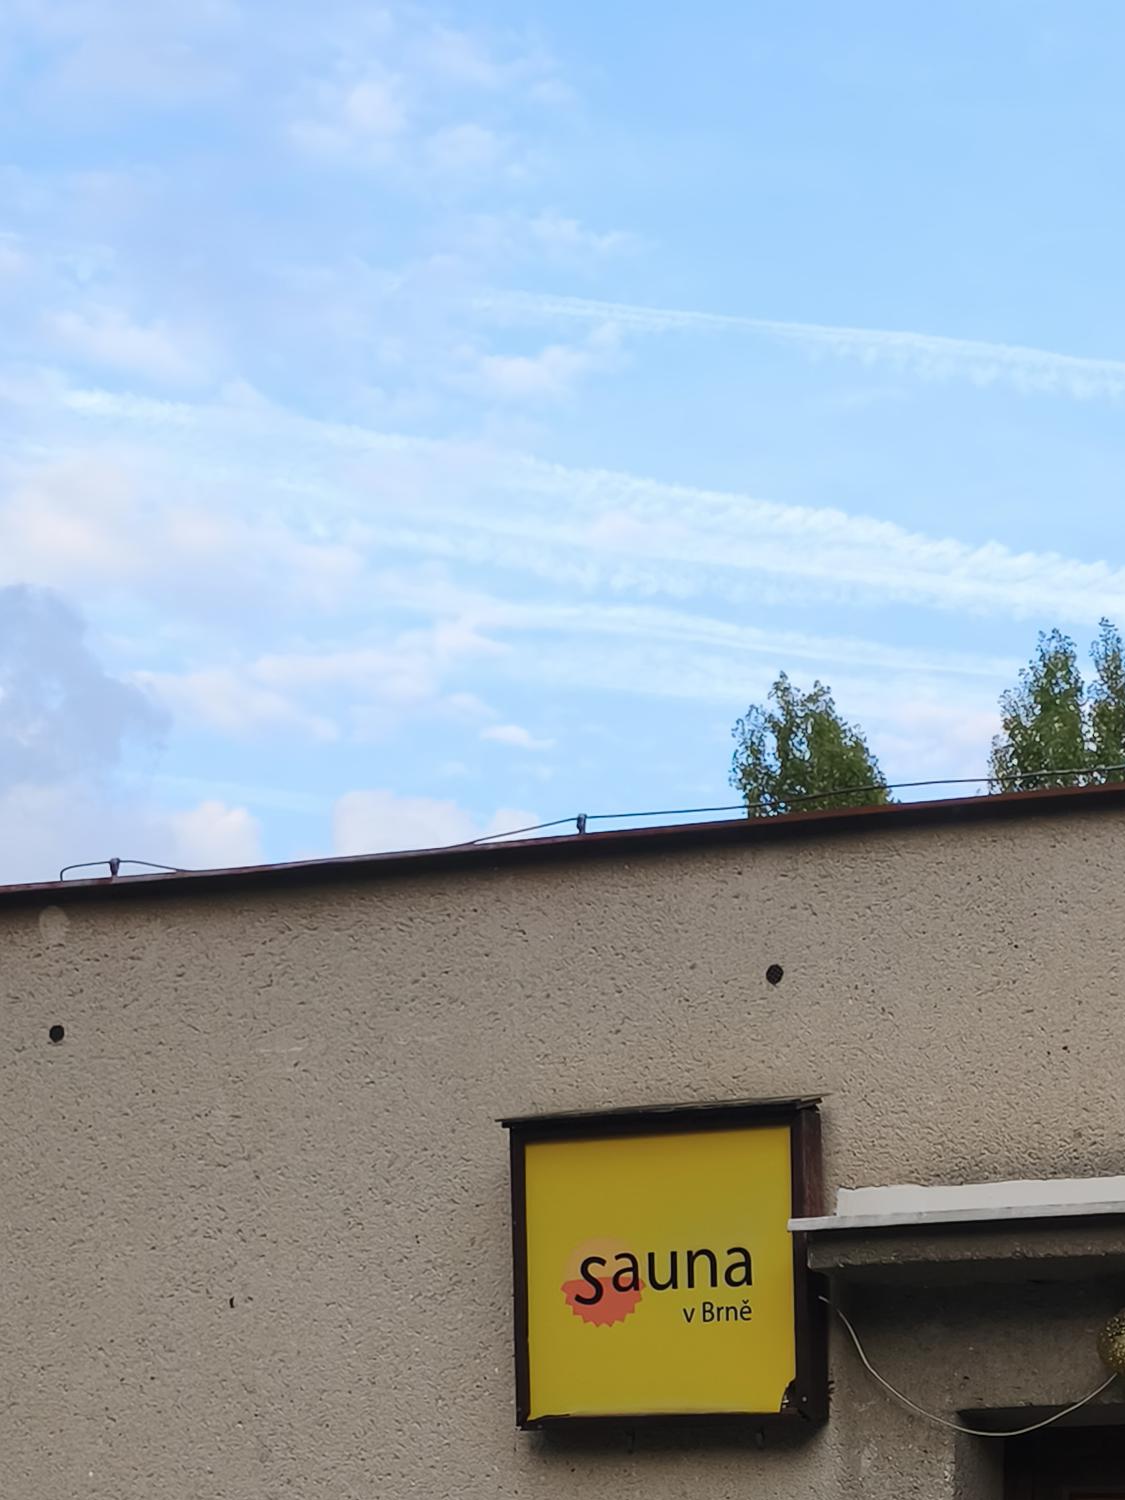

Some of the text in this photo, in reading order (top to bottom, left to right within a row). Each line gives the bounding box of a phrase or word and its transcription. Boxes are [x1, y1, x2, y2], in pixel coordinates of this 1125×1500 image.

[574, 1246, 753, 1305] sauna
[683, 1299, 752, 1323] v Brně
